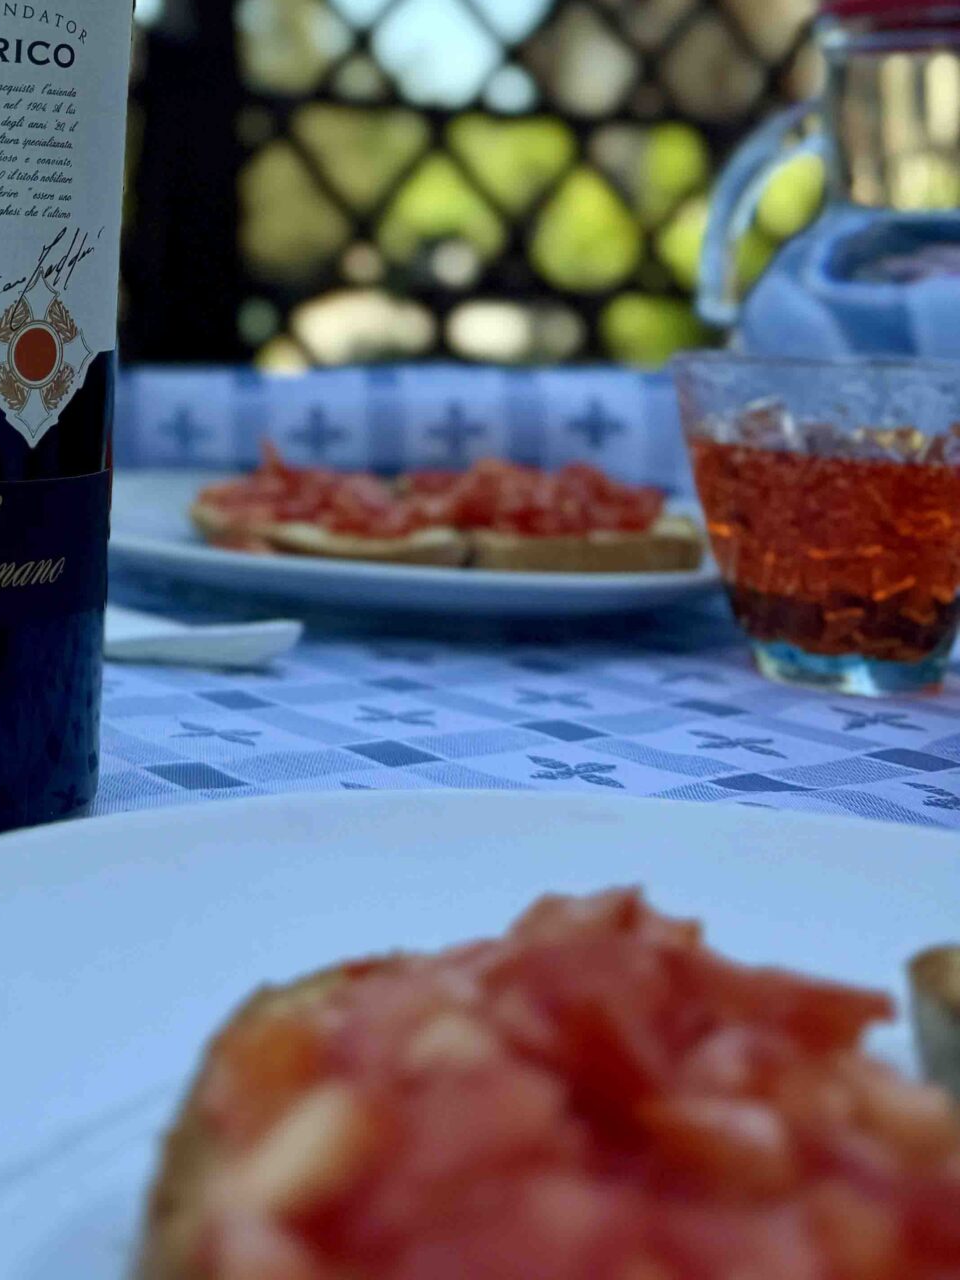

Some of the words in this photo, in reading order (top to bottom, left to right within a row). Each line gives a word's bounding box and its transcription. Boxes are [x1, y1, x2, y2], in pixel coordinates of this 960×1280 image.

[3, 98, 23, 110] nel
[0, 115, 25, 131] degli
[27, 120, 49, 130] anni
[68, 120, 79, 133] il
[7, 168, 19, 181] il
[16, 169, 39, 182] titolo
[39, 171, 73, 184] nobiliare
[24, 205, 39, 217] che
